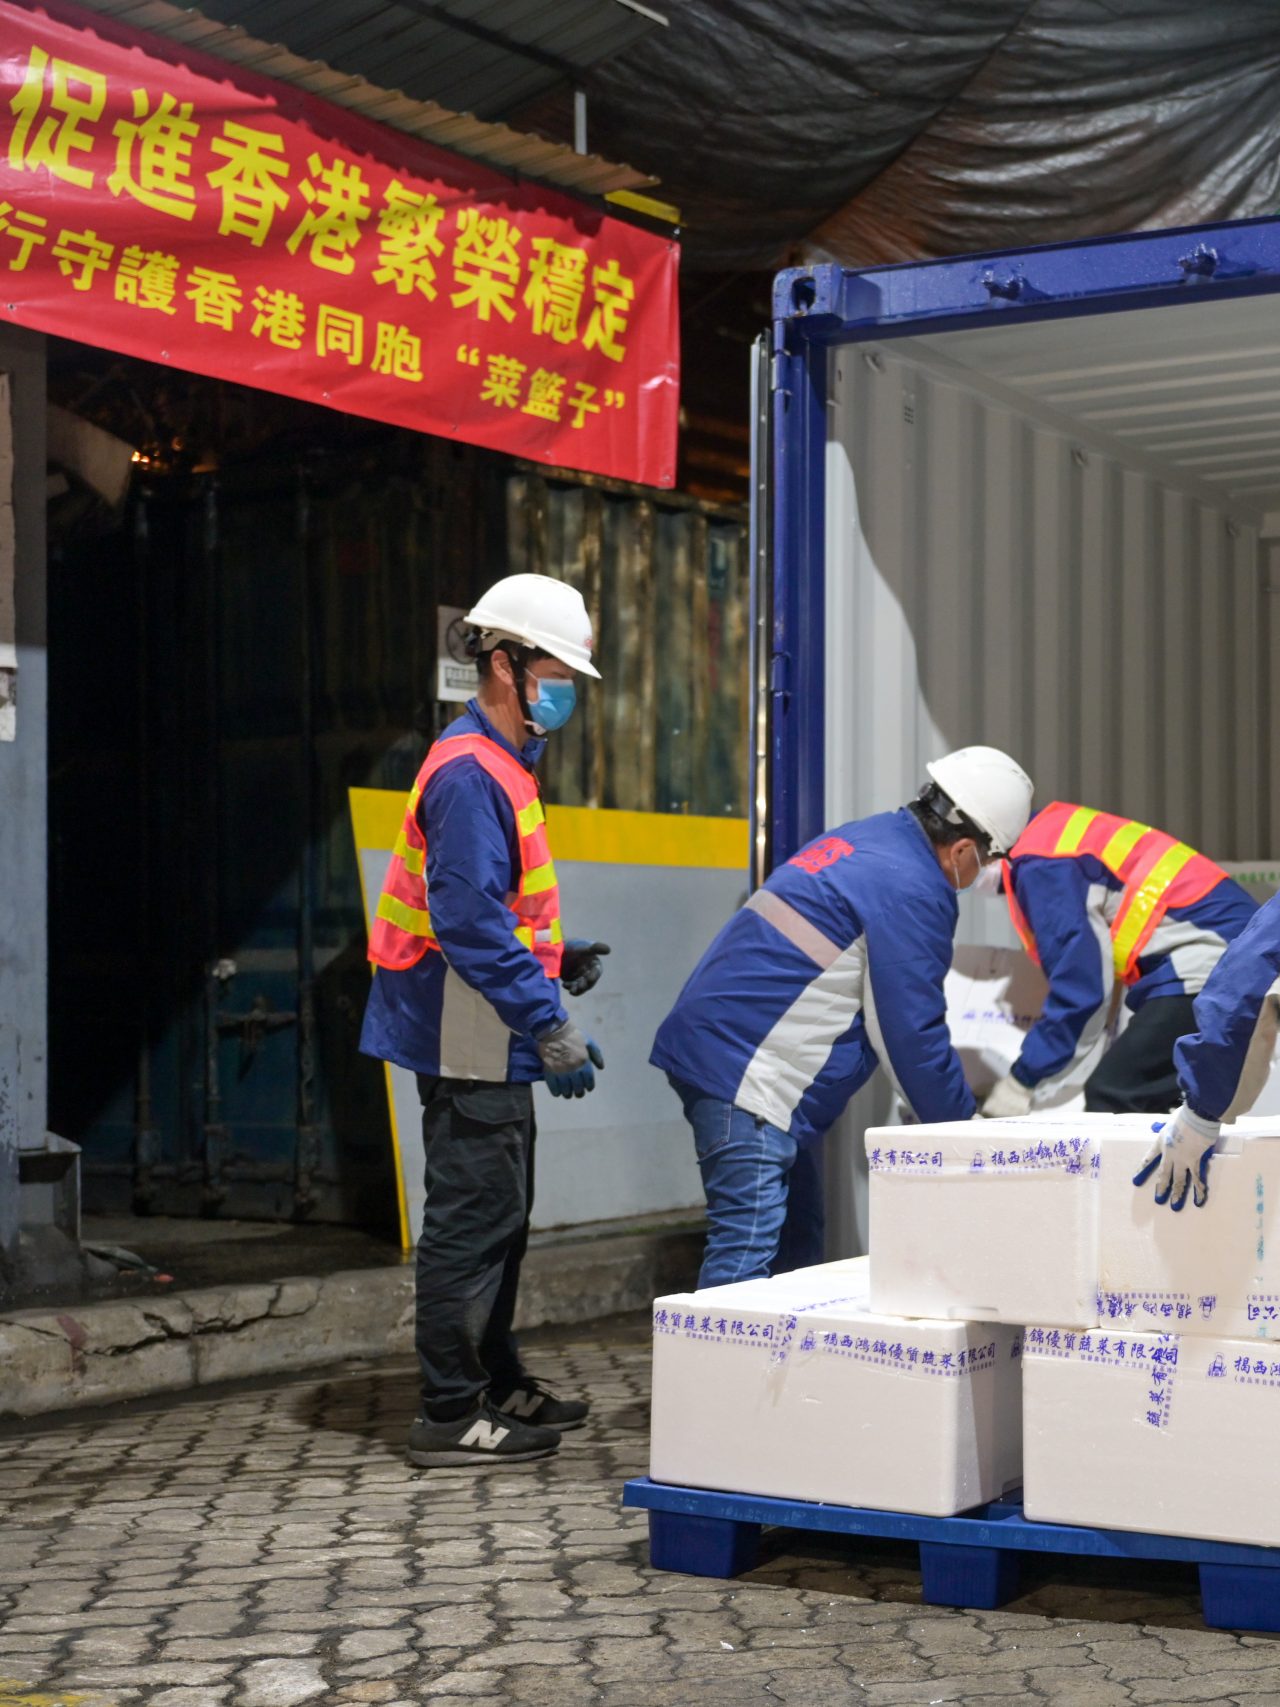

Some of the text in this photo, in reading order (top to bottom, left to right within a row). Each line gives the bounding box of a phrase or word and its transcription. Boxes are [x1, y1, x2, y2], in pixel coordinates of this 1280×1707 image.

[7, 45, 636, 362] 促進香港繁榮穩定
[458, 1419, 510, 1449] N
